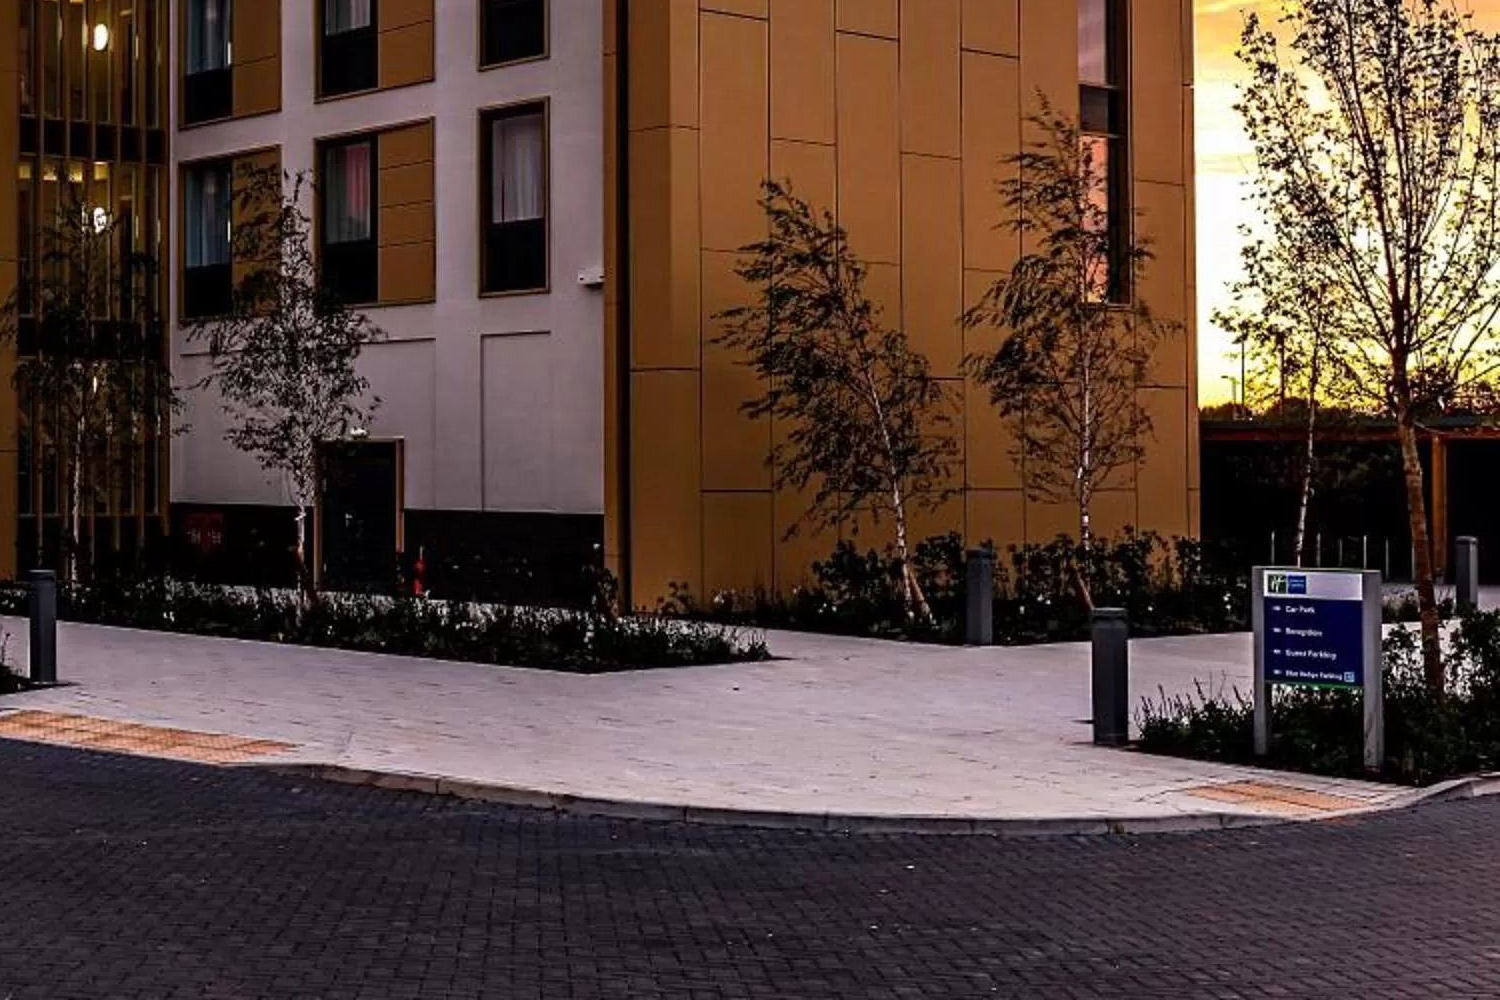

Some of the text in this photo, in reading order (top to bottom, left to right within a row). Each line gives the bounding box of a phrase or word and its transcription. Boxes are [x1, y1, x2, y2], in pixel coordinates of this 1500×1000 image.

[1285, 605, 1316, 614] Car Park
[1285, 627, 1323, 637] Reception
[1308, 650, 1337, 661] Parking
